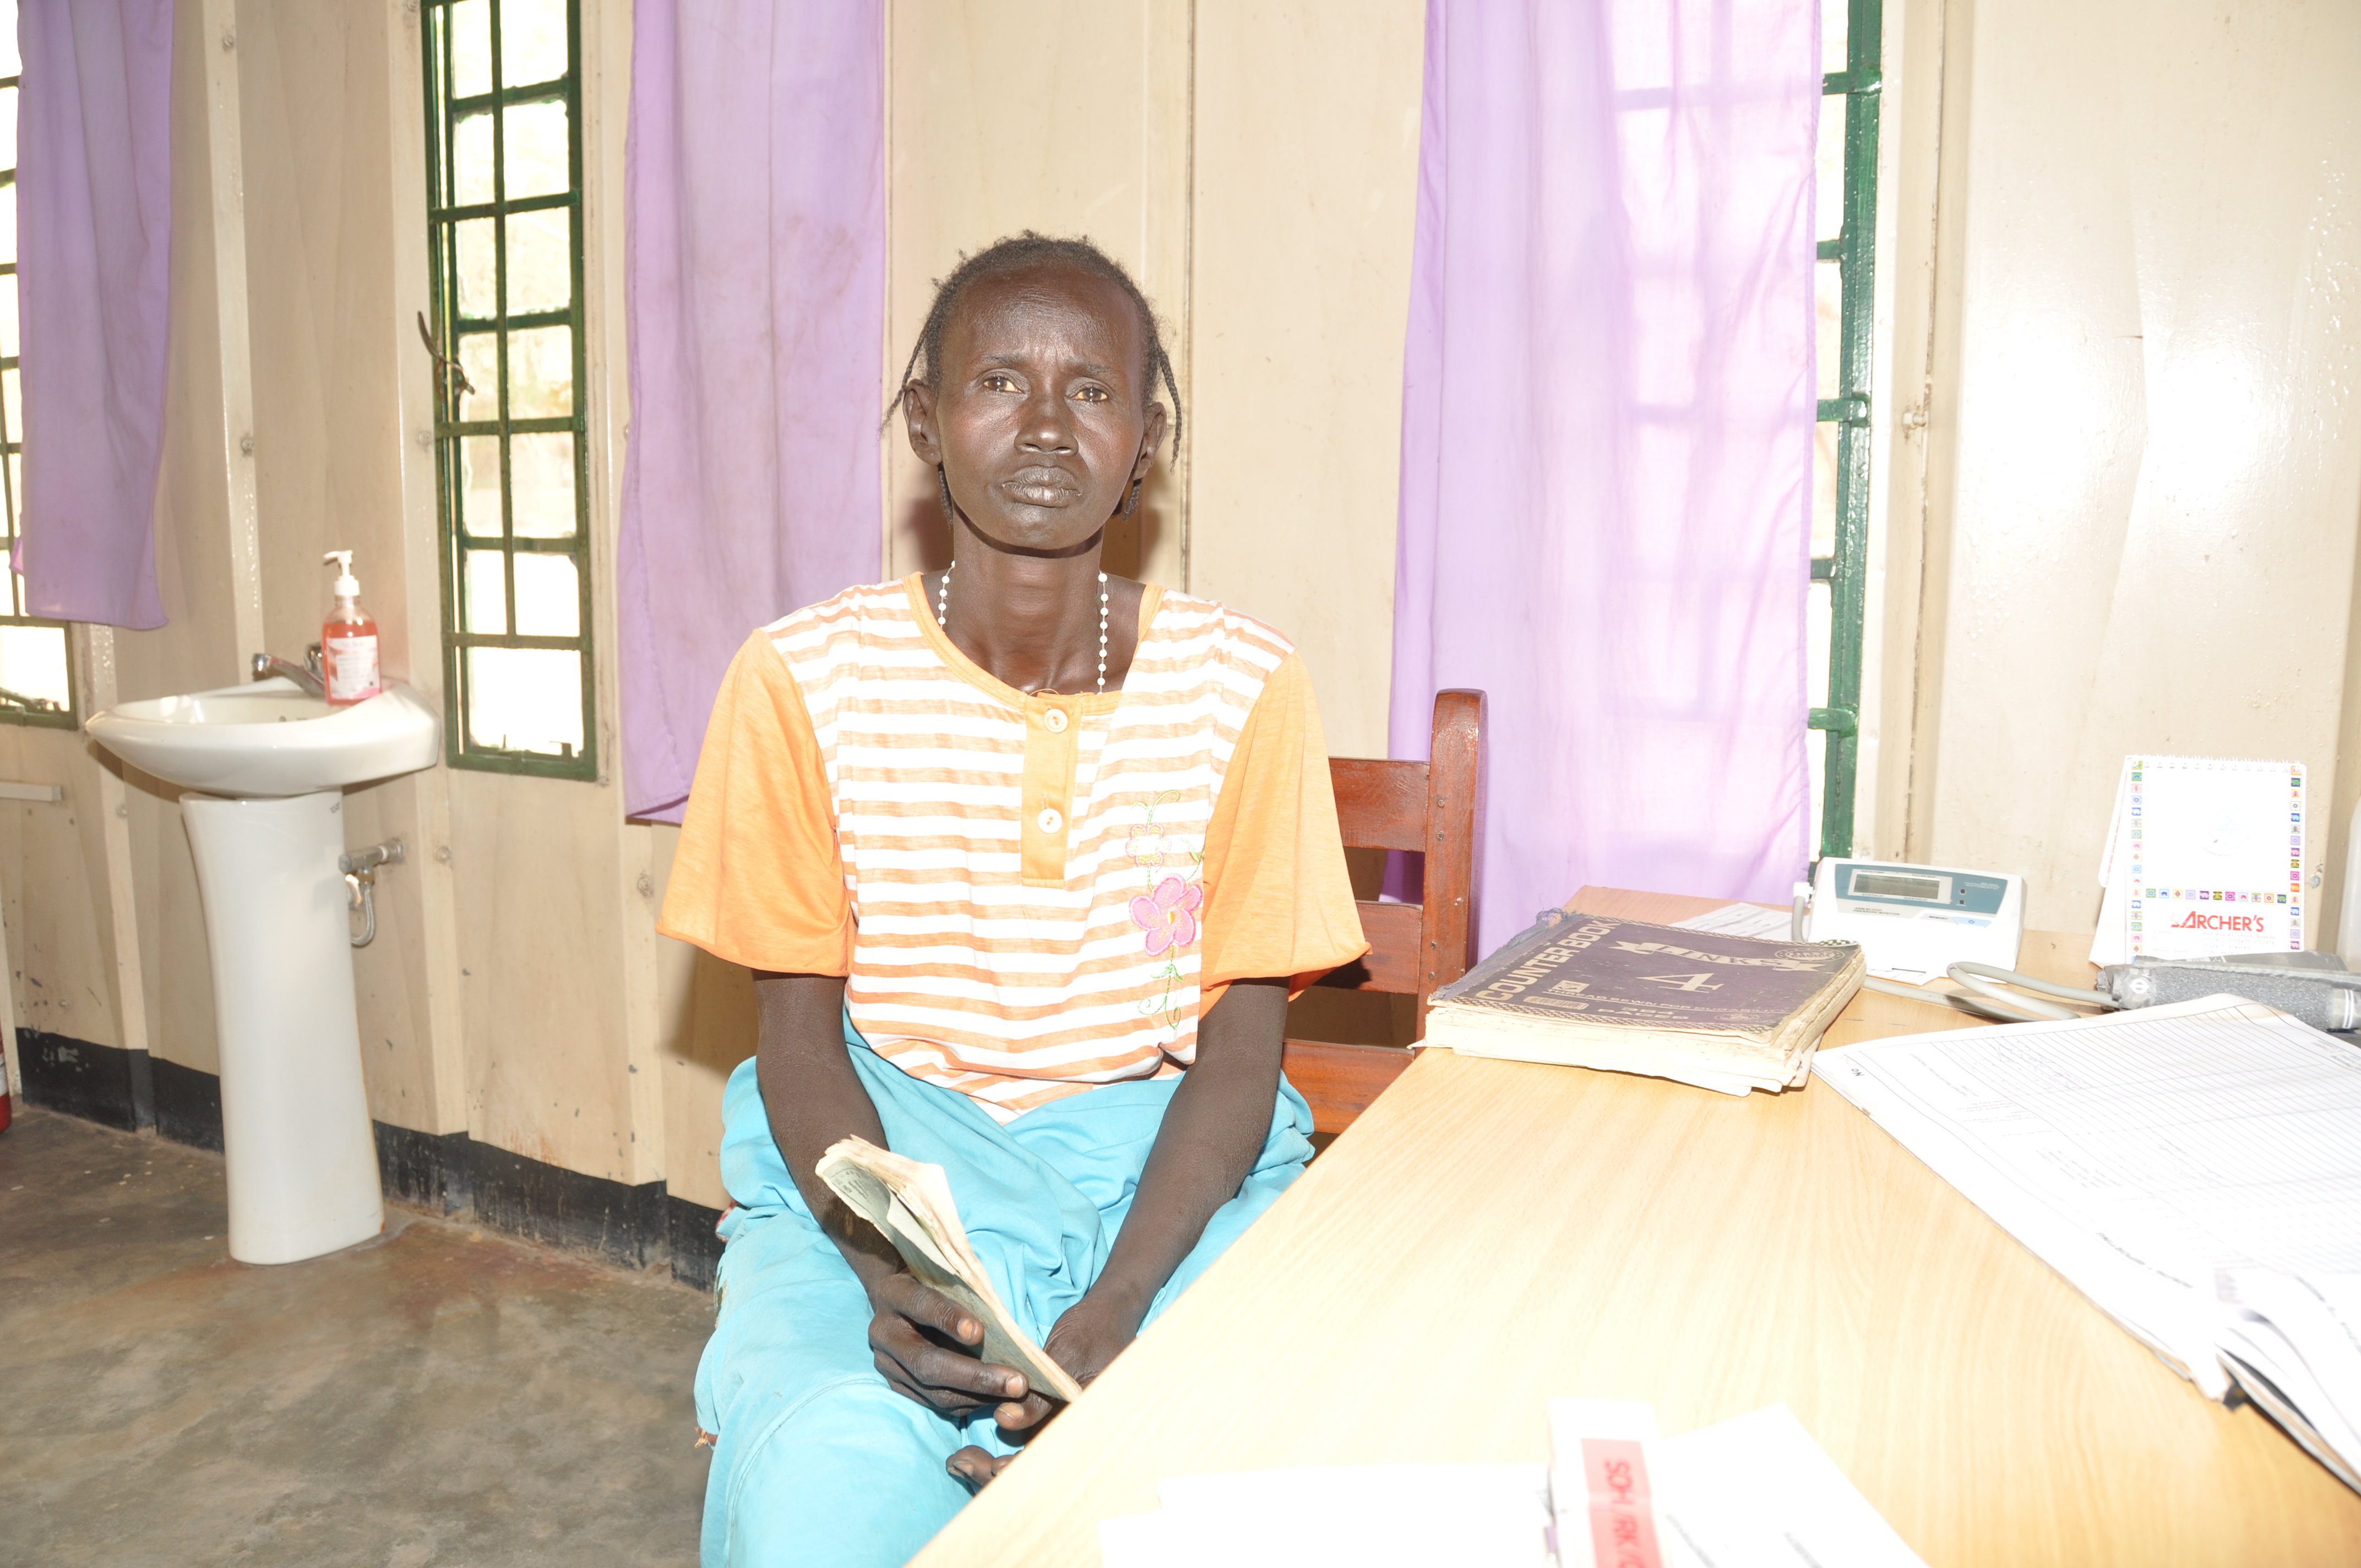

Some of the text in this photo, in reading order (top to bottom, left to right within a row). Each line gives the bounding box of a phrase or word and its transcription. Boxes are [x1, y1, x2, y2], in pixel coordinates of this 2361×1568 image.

[2171, 910, 2265, 933] ARCHER'S
[1476, 919, 1622, 1001] COUNTER BOOK
[1656, 945, 1785, 966] LINKS
[1636, 972, 1725, 993] 4
[1547, 988, 1607, 1000] THREAD
[1610, 997, 1657, 1006] SEWN
[1598, 1008, 1689, 1020] PAGES
